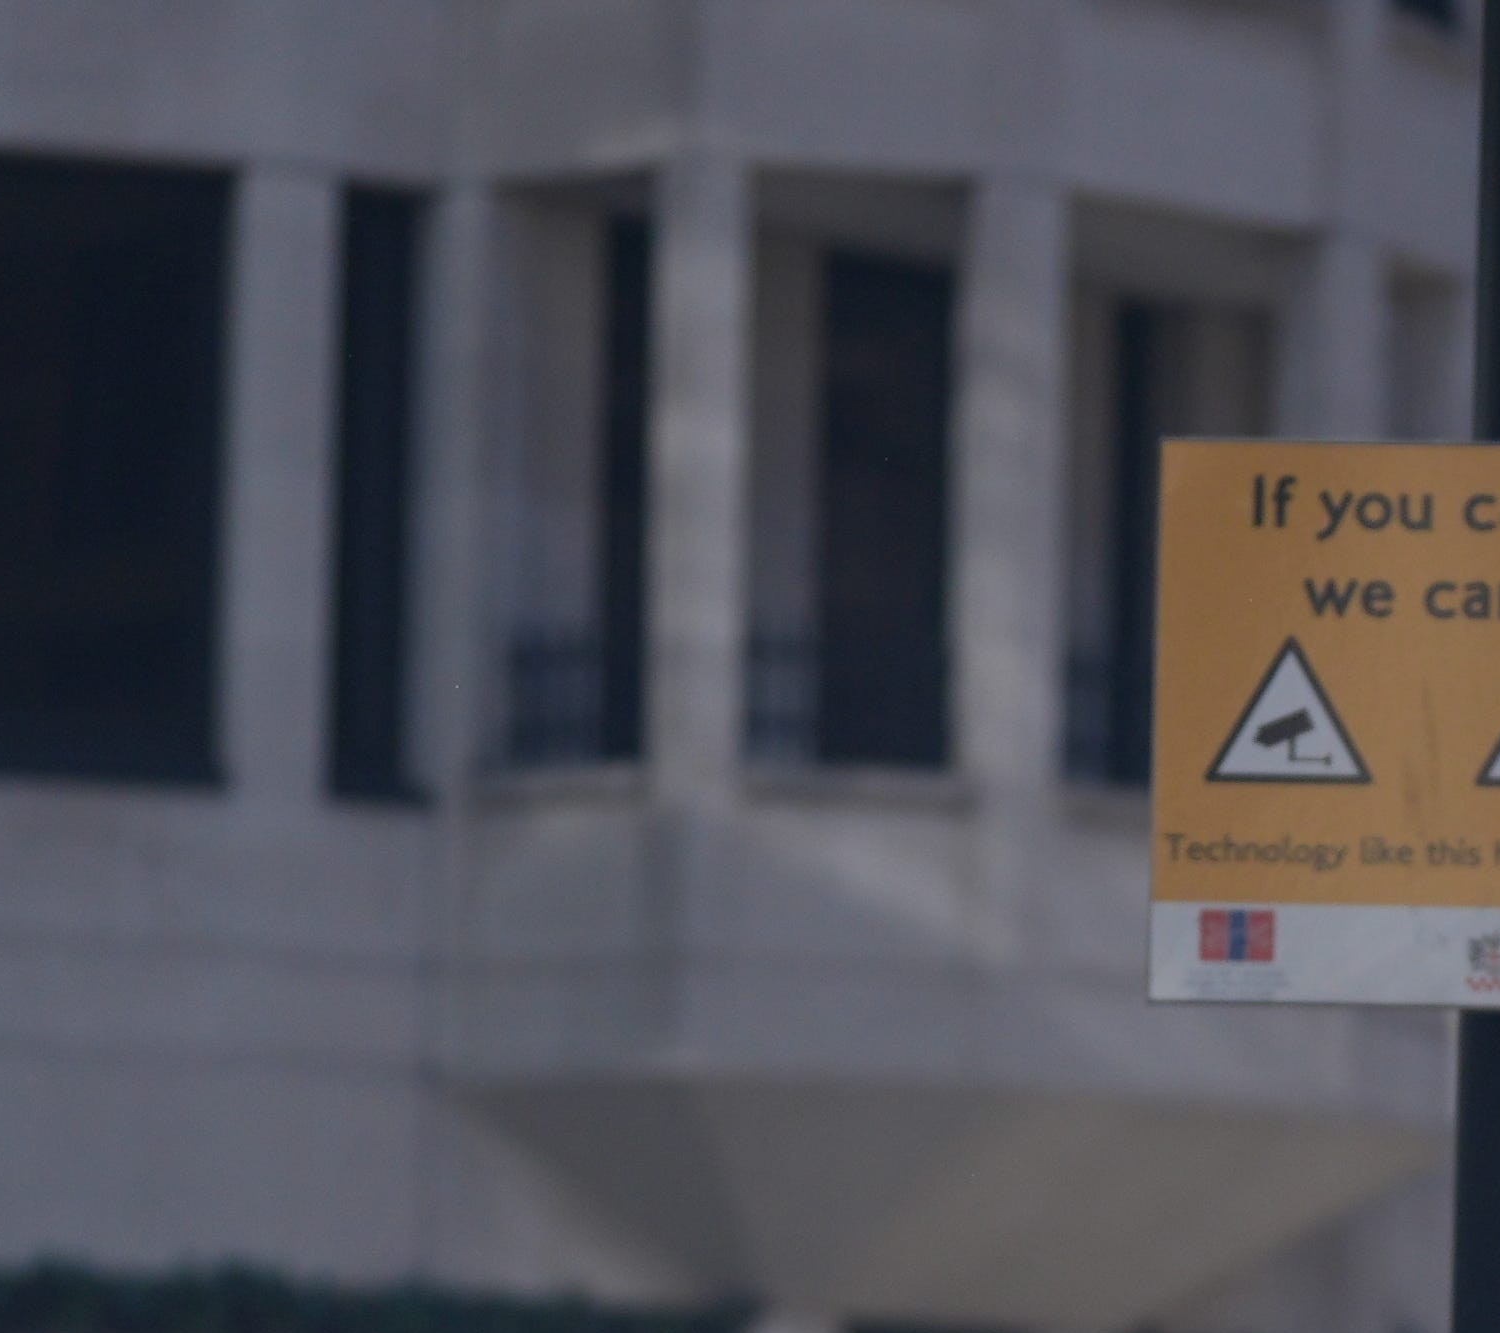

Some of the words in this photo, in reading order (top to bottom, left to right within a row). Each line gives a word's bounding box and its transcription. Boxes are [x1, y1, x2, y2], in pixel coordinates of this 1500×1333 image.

[1251, 473, 1297, 529] If
[1314, 488, 1434, 542] you
[1302, 576, 1396, 619] we
[1163, 832, 1347, 872] Technology
[1359, 834, 1415, 867] like
[1424, 837, 1483, 869] this
